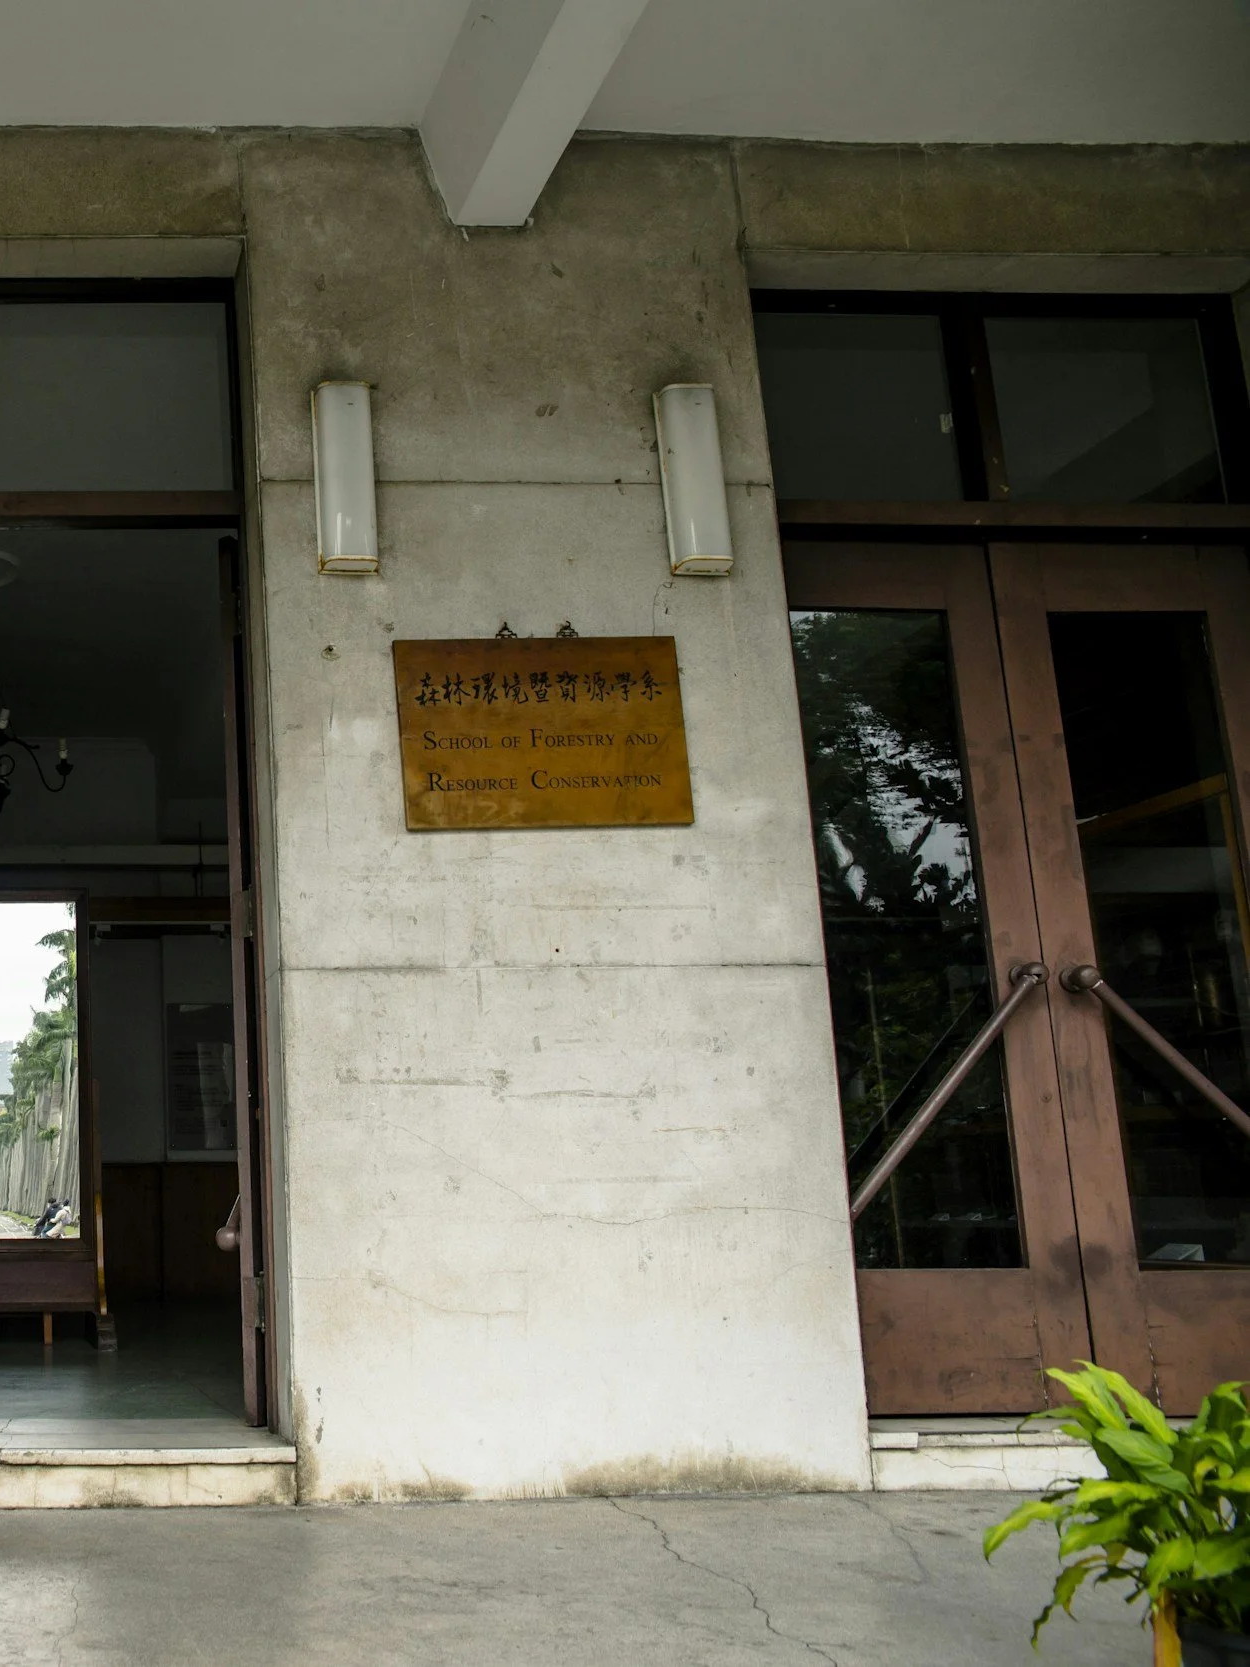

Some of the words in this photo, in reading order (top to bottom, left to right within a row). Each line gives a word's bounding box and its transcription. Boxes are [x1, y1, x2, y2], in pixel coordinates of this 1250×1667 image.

[414, 670, 662, 706] 森林環境暨資源學系
